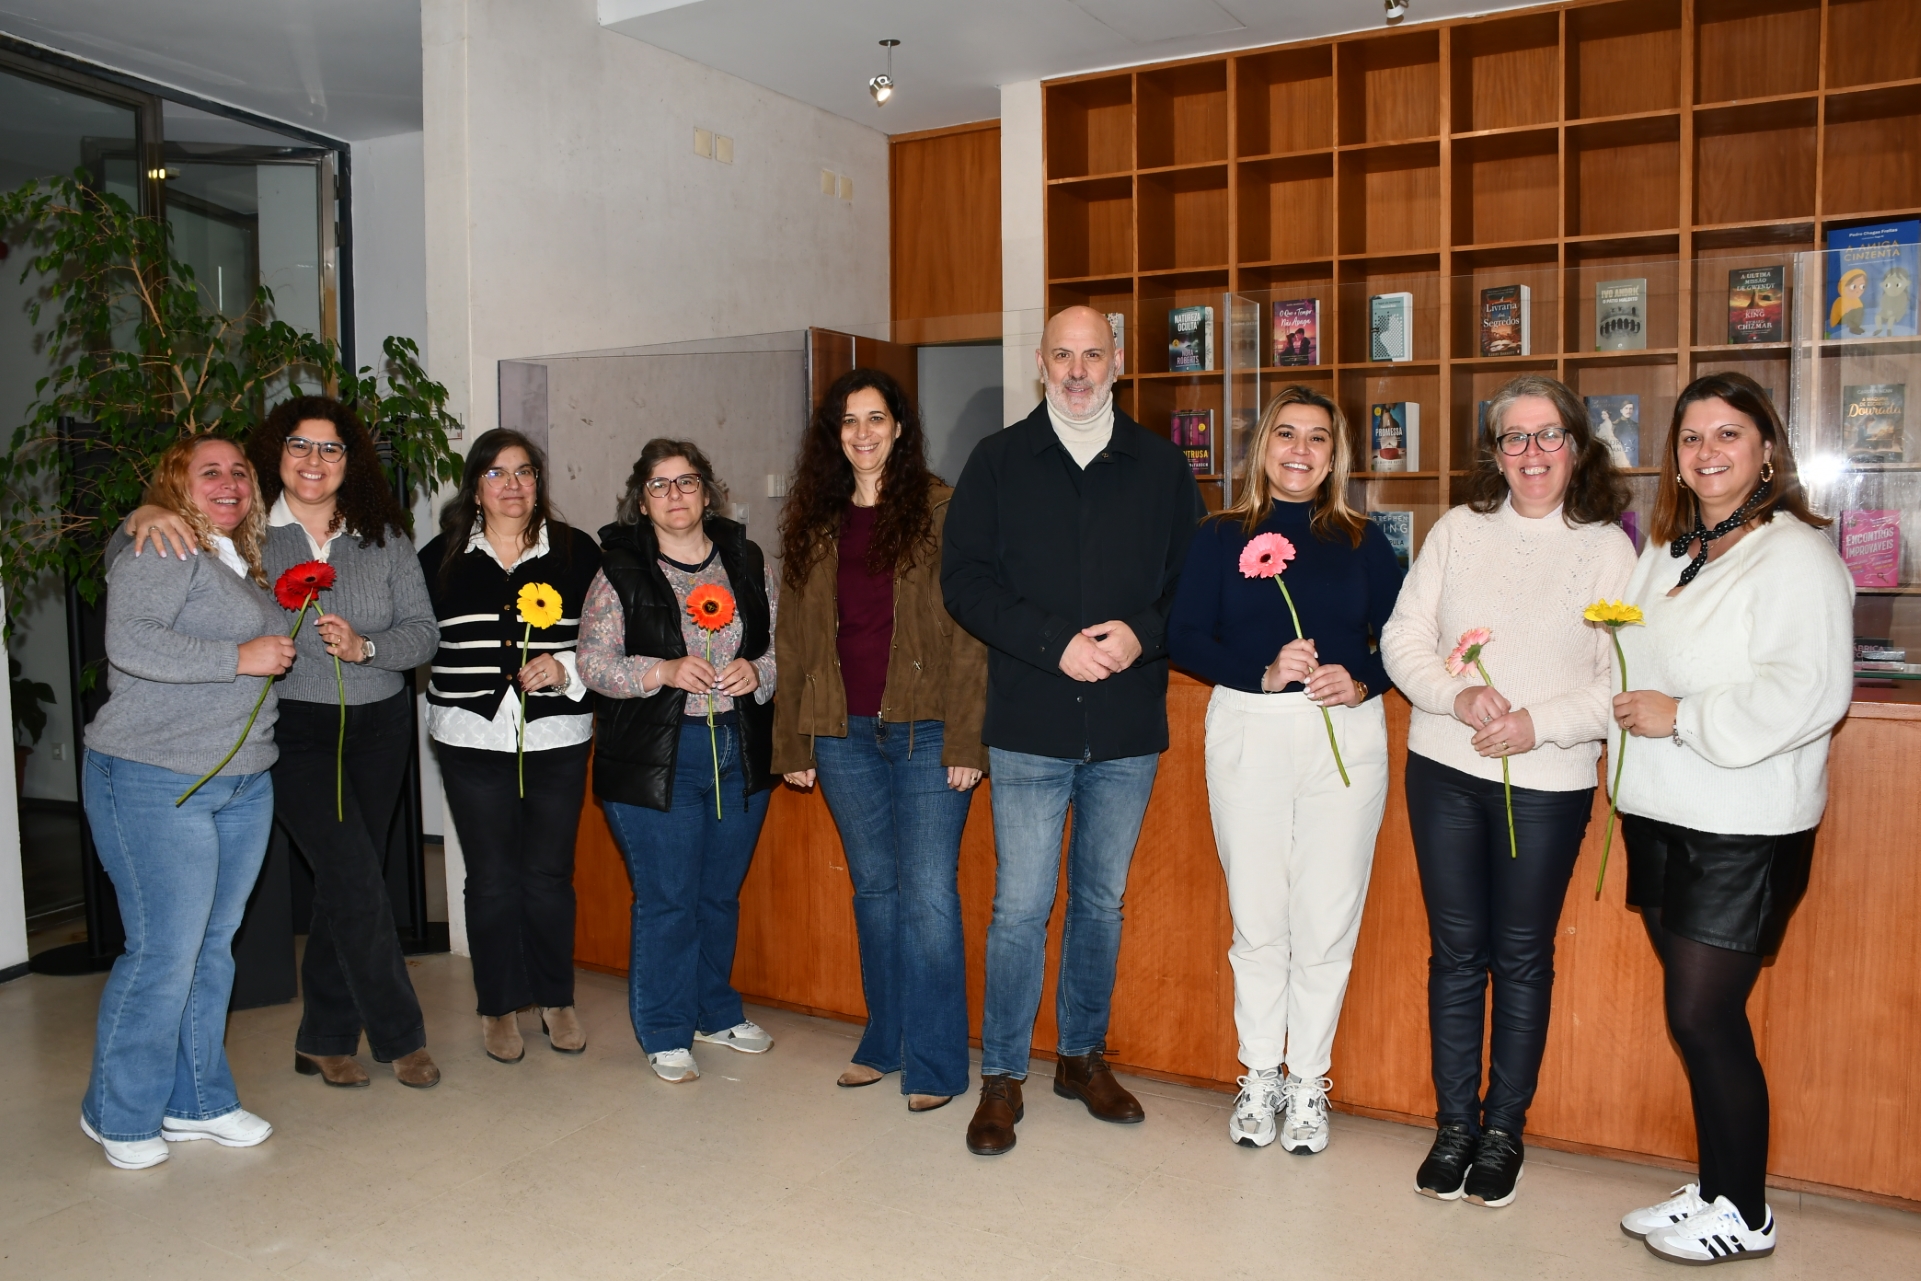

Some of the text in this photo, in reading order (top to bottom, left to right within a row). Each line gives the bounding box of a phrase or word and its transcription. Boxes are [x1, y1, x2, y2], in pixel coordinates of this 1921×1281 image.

[1859, 240, 1899, 251] AMIGA
[1844, 249, 1900, 261] CINZENTA
[1601, 290, 1613, 298] IVO
[1486, 303, 1517, 312] Livraria
[1174, 312, 1202, 324] NATUREZA
[1483, 317, 1520, 328] Segredos
[1177, 321, 1198, 332] OCULTA
[1176, 356, 1200, 365] ROBERTS
[1847, 403, 1901, 417] Dourada
[1375, 427, 1403, 437] PROMESSA
[1846, 527, 1894, 546] ENCONTROS
